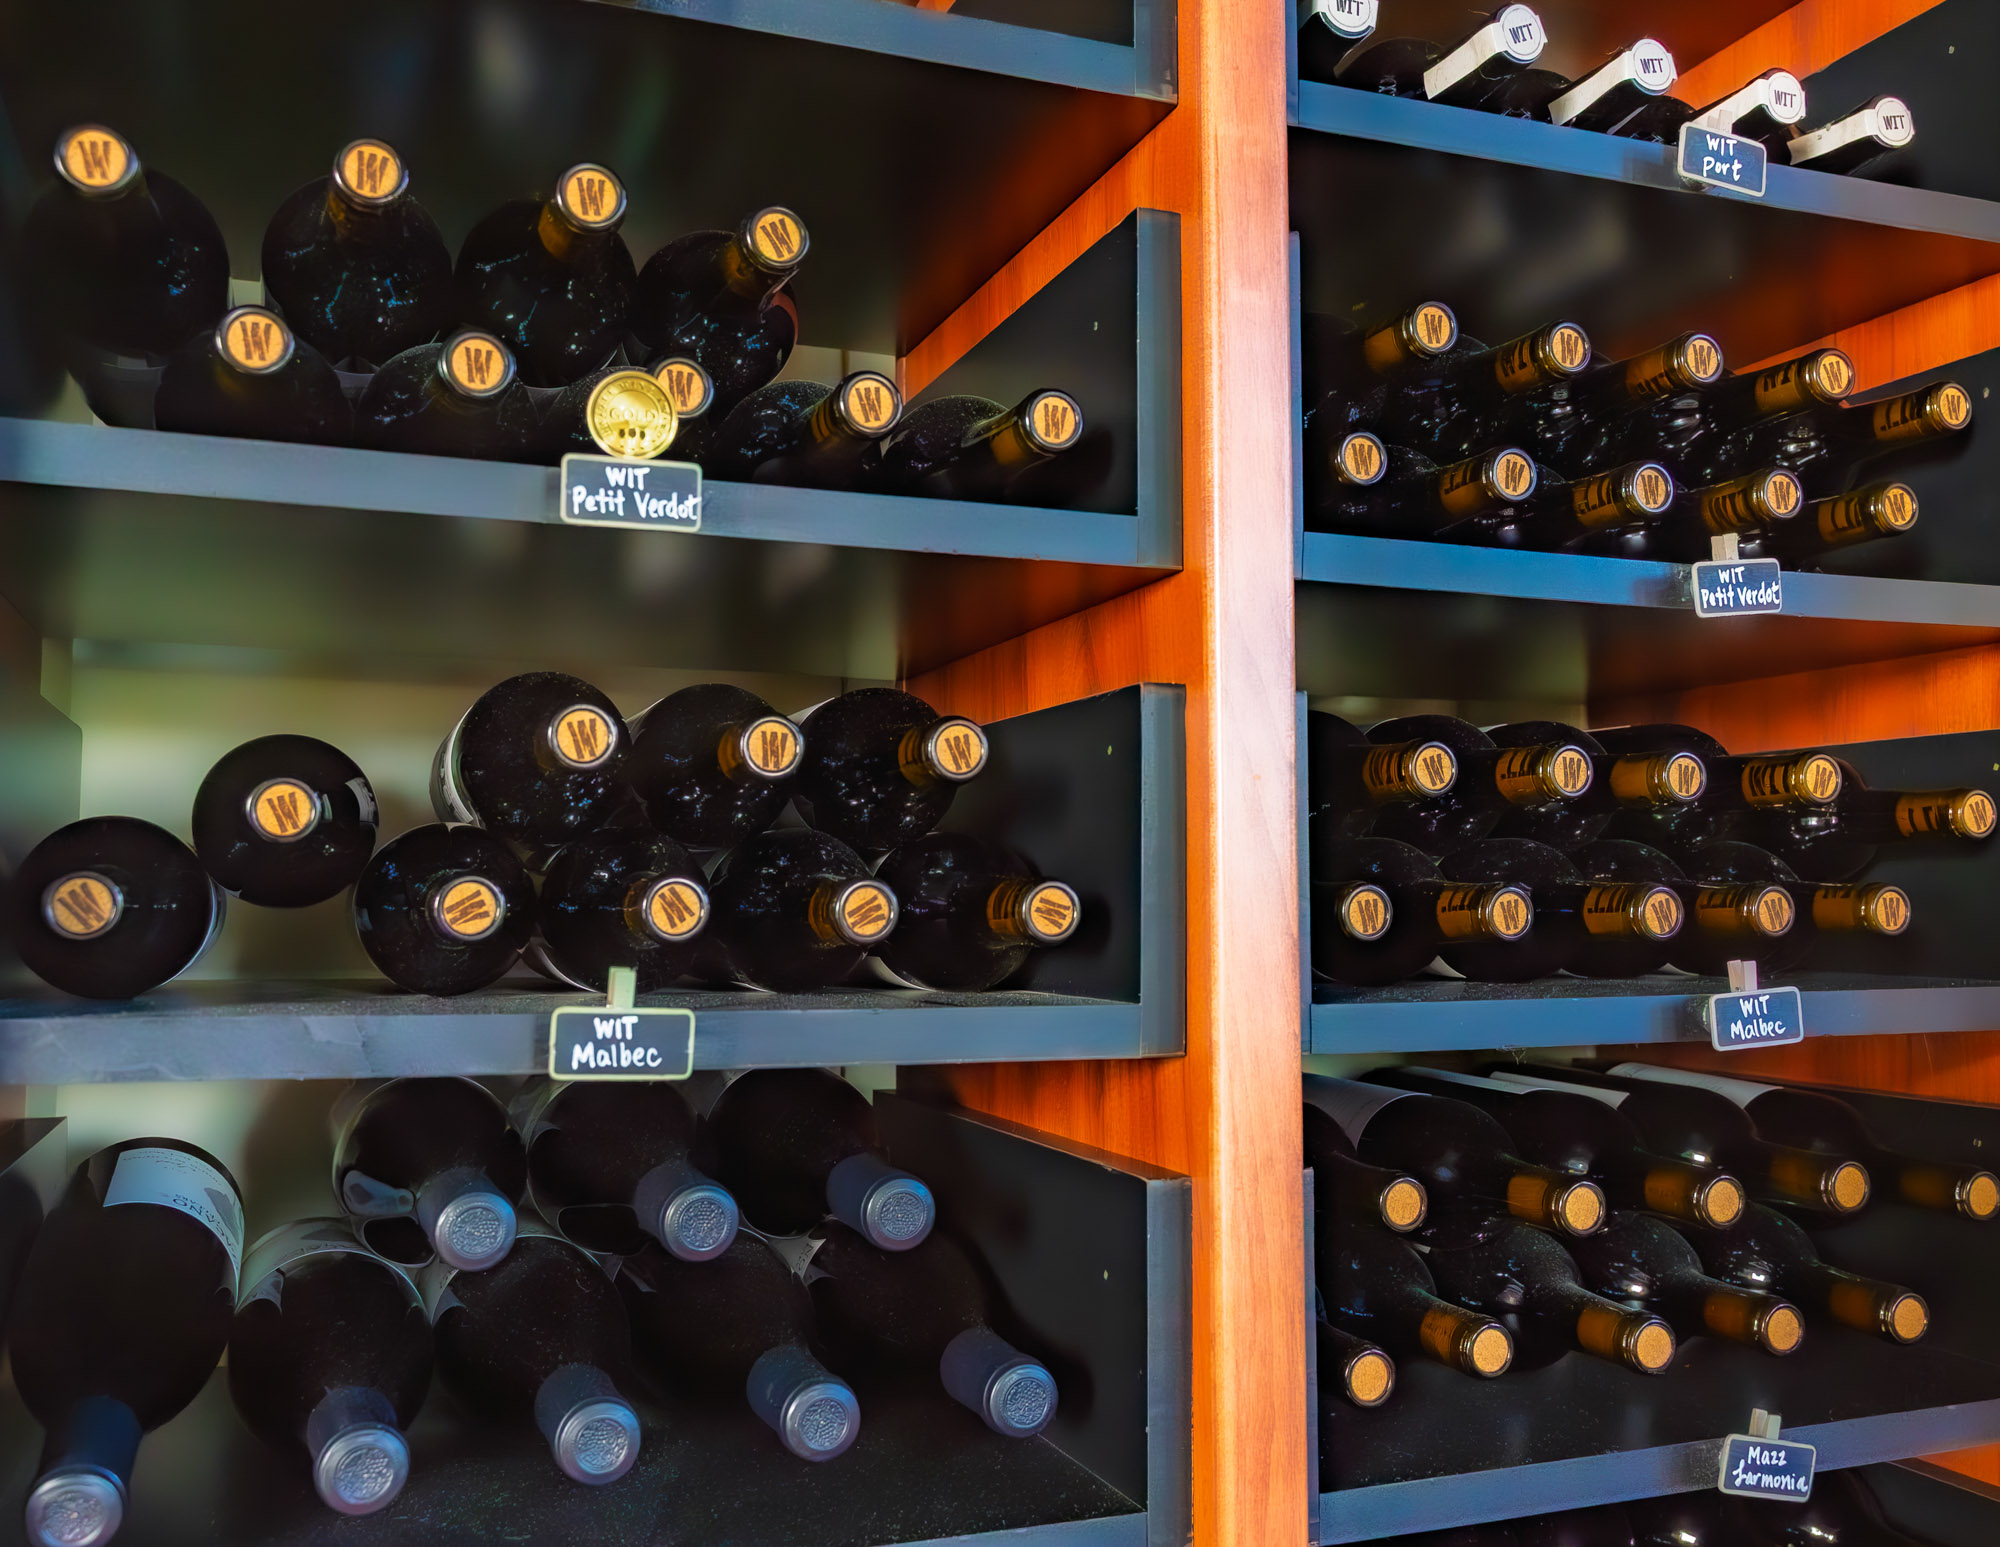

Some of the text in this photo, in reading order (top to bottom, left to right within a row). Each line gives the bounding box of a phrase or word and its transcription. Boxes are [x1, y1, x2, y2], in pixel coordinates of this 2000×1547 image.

[1508, 23, 1533, 44] WIT
[1640, 57, 1664, 75] WIT
[1773, 89, 1796, 108] WIT
[1882, 114, 1906, 131] WIT
[77, 140, 112, 179] W
[1706, 134, 1738, 157] WIT
[356, 150, 390, 194] W
[1702, 156, 1742, 182] Port
[576, 177, 606, 216] W
[759, 217, 794, 259] W
[239, 320, 273, 362] W
[1423, 313, 1443, 345] W
[1559, 331, 1580, 366] W
[1691, 344, 1713, 376] W
[464, 346, 493, 385] W
[1822, 360, 1843, 393] W
[667, 368, 695, 408] W
[854, 386, 881, 424] W
[1044, 403, 1069, 440] W
[1944, 393, 1962, 422] W
[1351, 442, 1373, 477] W
[1504, 458, 1525, 493] W
[605, 466, 650, 491] WIT
[1641, 474, 1659, 506] W
[572, 485, 702, 520] Petit Verdot
[1772, 480, 1791, 511] W
[1883, 492, 1907, 523] W
[1718, 566, 1745, 584] WIT
[1700, 580, 1780, 609] Petit Verdot
[566, 718, 598, 760] W
[760, 730, 789, 769] W
[944, 733, 972, 771] W
[1422, 753, 1445, 787] W
[1561, 756, 1582, 789] W
[1677, 763, 1697, 794] W
[1813, 764, 1834, 797] W
[266, 791, 301, 834] W
[1970, 798, 1988, 832] W
[1356, 898, 1380, 934] W
[1499, 898, 1520, 932] W
[1650, 897, 1674, 933] W
[1763, 897, 1785, 931] W
[1882, 896, 1901, 928] W
[1739, 994, 1770, 1017] WIT
[593, 1015, 639, 1040] WIT
[1730, 1018, 1786, 1041] Malbec
[571, 1041, 663, 1070] Malbec
